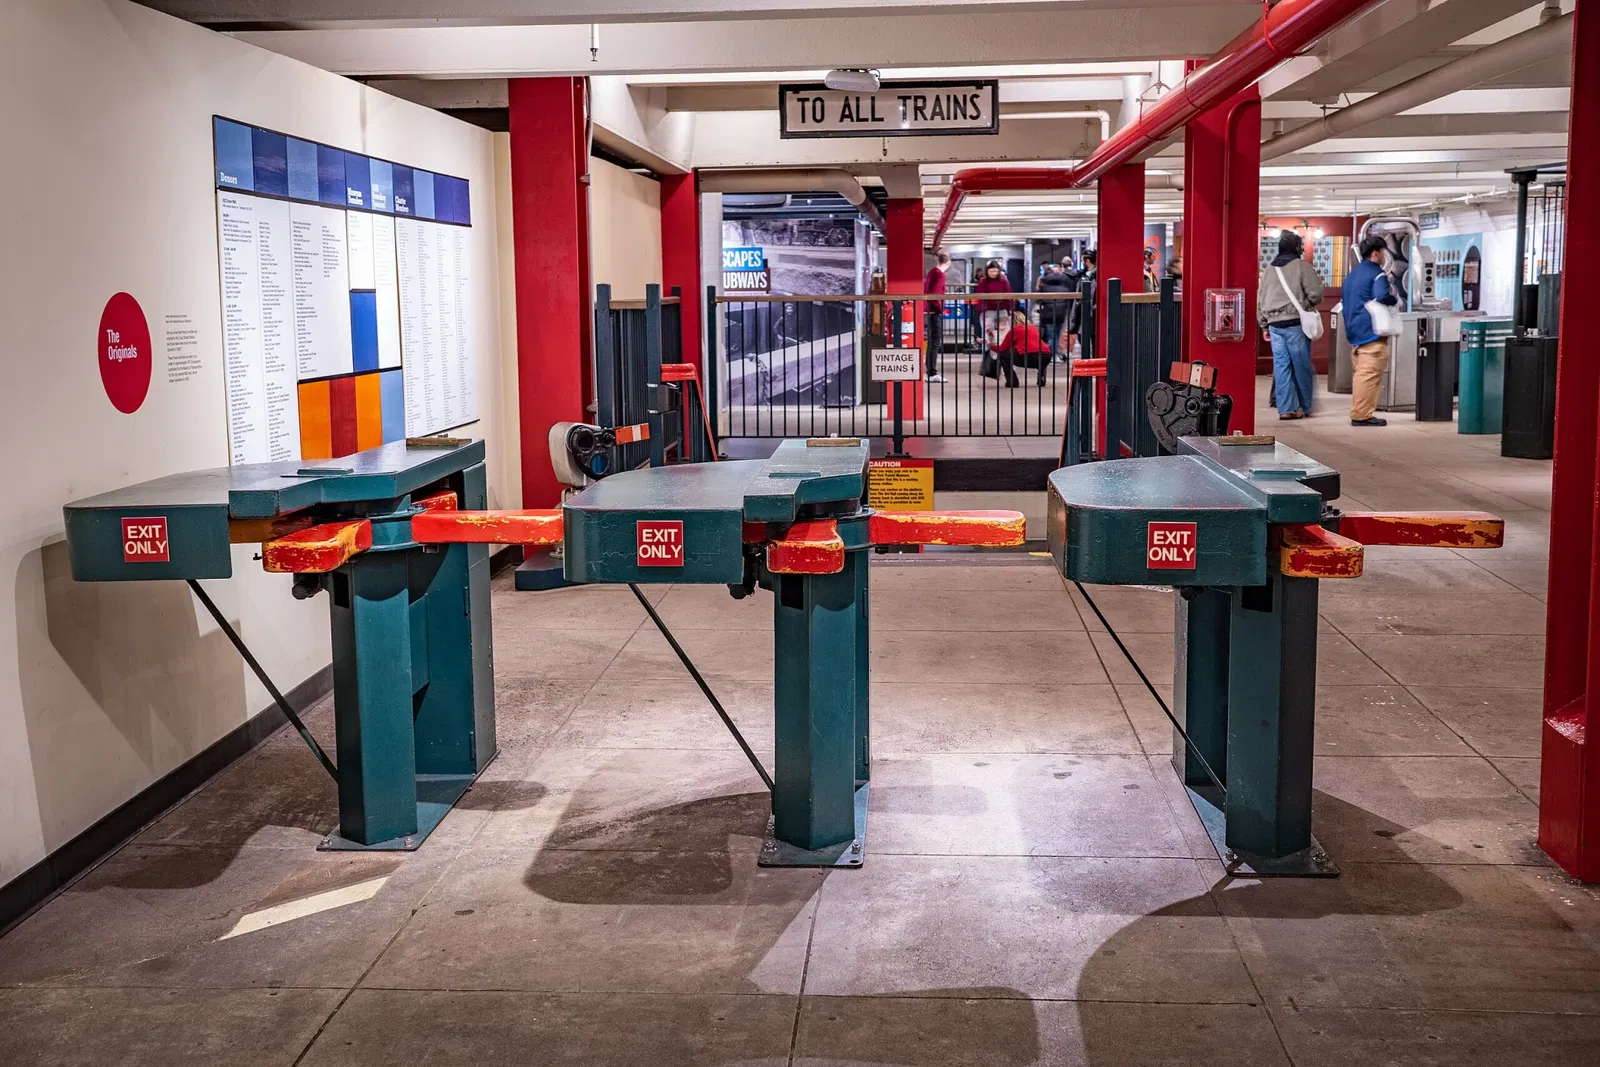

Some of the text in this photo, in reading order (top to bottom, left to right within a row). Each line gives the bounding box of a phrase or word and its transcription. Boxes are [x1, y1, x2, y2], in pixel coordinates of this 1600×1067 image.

[797, 93, 981, 123] TO ALL TRAINS
[220, 172, 238, 185] Donors
[723, 271, 768, 289] UBWAYS
[106, 329, 120, 344] The
[108, 344, 138, 363] Originals
[875, 353, 914, 362] VINTAGE
[875, 364, 909, 373] TRAINS
[127, 525, 162, 539] EXIT
[642, 528, 678, 543] EXIT
[1153, 530, 1191, 545] EXIT
[125, 540, 167, 555] ONLY
[639, 544, 682, 559] ONLY
[1149, 546, 1195, 562] ONLY
